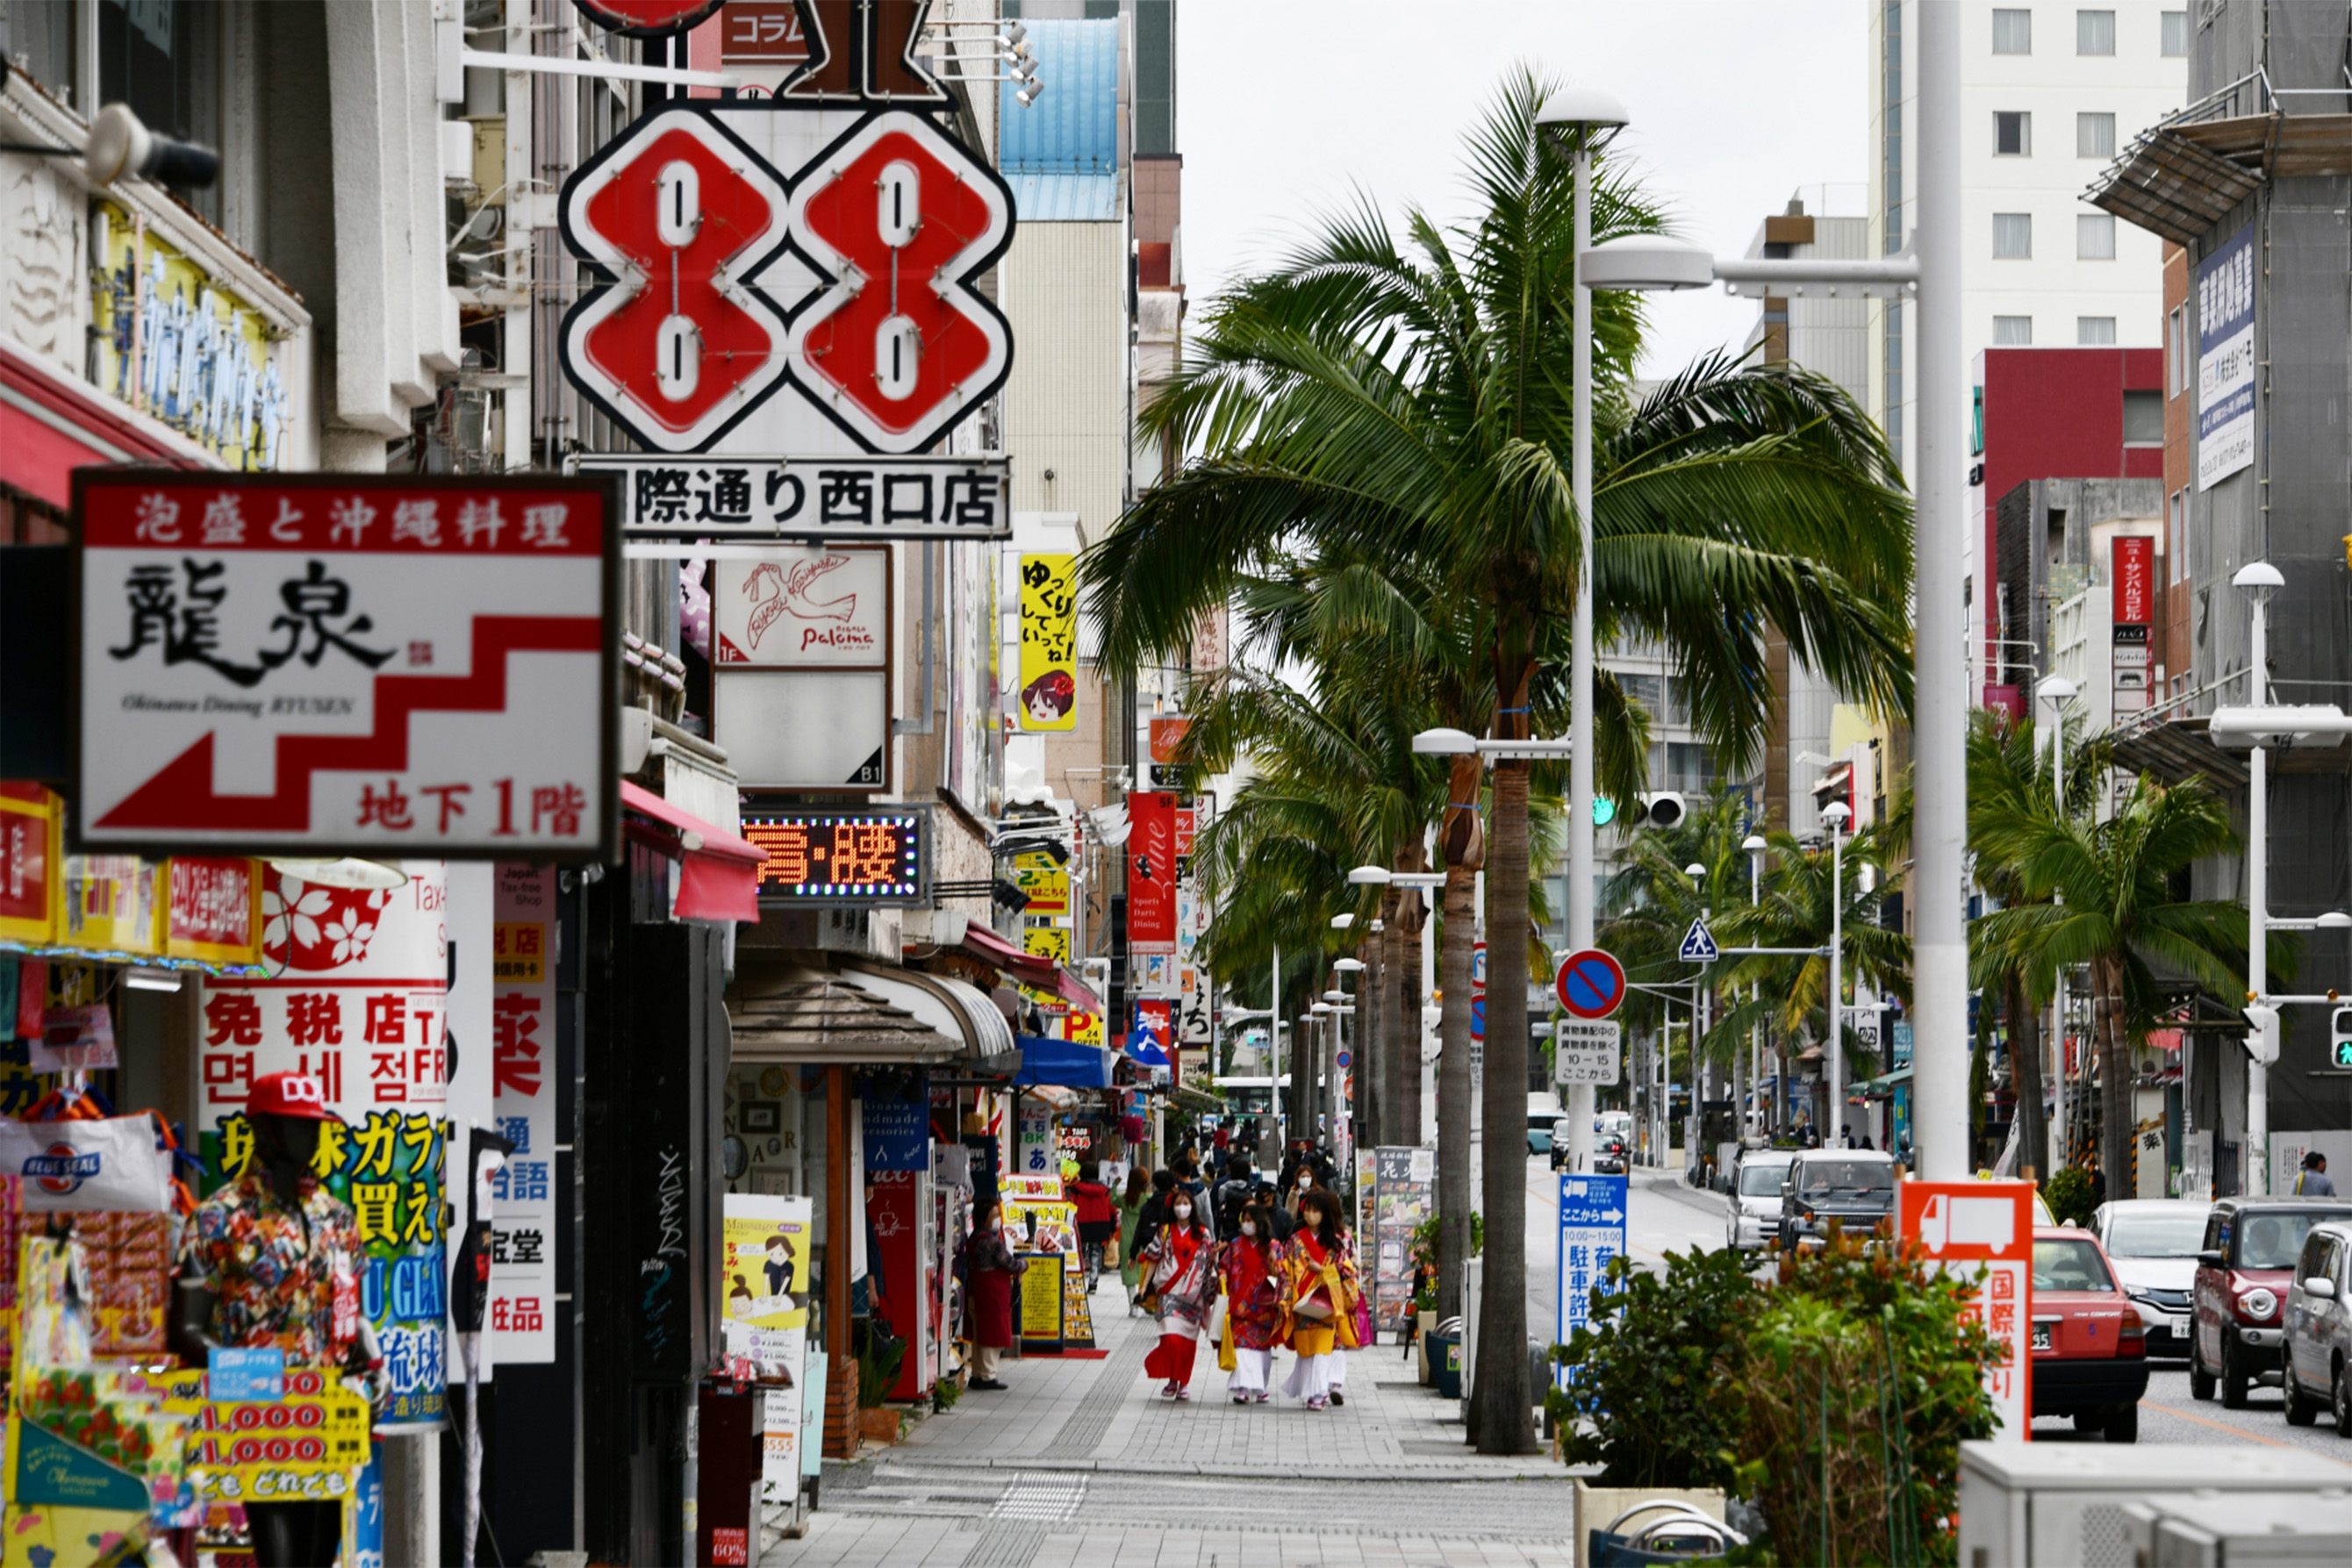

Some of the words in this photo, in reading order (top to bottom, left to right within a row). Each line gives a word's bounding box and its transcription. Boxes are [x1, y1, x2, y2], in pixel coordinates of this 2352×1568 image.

[617, 468, 999, 527] 際通り西口店
[135, 493, 570, 548] 泡盛と沖縄料理
[108, 558, 398, 688] 龍泉
[721, 647, 737, 661] 1F
[1152, 727, 1181, 748] Lin
[861, 766, 880, 782] B1
[355, 778, 587, 837] 地下1階
[411, 876, 447, 912] Tax-
[501, 882, 541, 892] Tax-free
[1026, 887, 1067, 897] 口はこちら
[515, 894, 541, 906] Shop
[1133, 897, 1159, 906] Sports
[1134, 920, 1160, 930] Dining
[204, 992, 406, 1047] 免税店
[1064, 1010, 1091, 1042] P
[1086, 1029, 1098, 1038] 24
[1561, 1040, 1616, 1051] 貨物車を除く
[414, 1049, 447, 1083] FR
[1563, 1068, 1612, 1080] ここから
[204, 1051, 406, 1104] 면세점
[864, 1101, 909, 1111] kinawa
[864, 1113, 920, 1124] ndmade
[863, 1126, 915, 1137] cessories
[27, 1159, 57, 1173] BLUE
[62, 1156, 99, 1173] SEAL
[1029, 1148, 1047, 1171] あ
[1561, 1208, 1600, 1222] ここから
[394, 1259, 446, 1318] GLA
[2033, 1333, 2049, 1348] 95
[202, 1405, 326, 1434] 1,000
[202, 1438, 326, 1466] 1,000
[254, 1469, 348, 1498] どれでも
[713, 1543, 746, 1557] 60%
